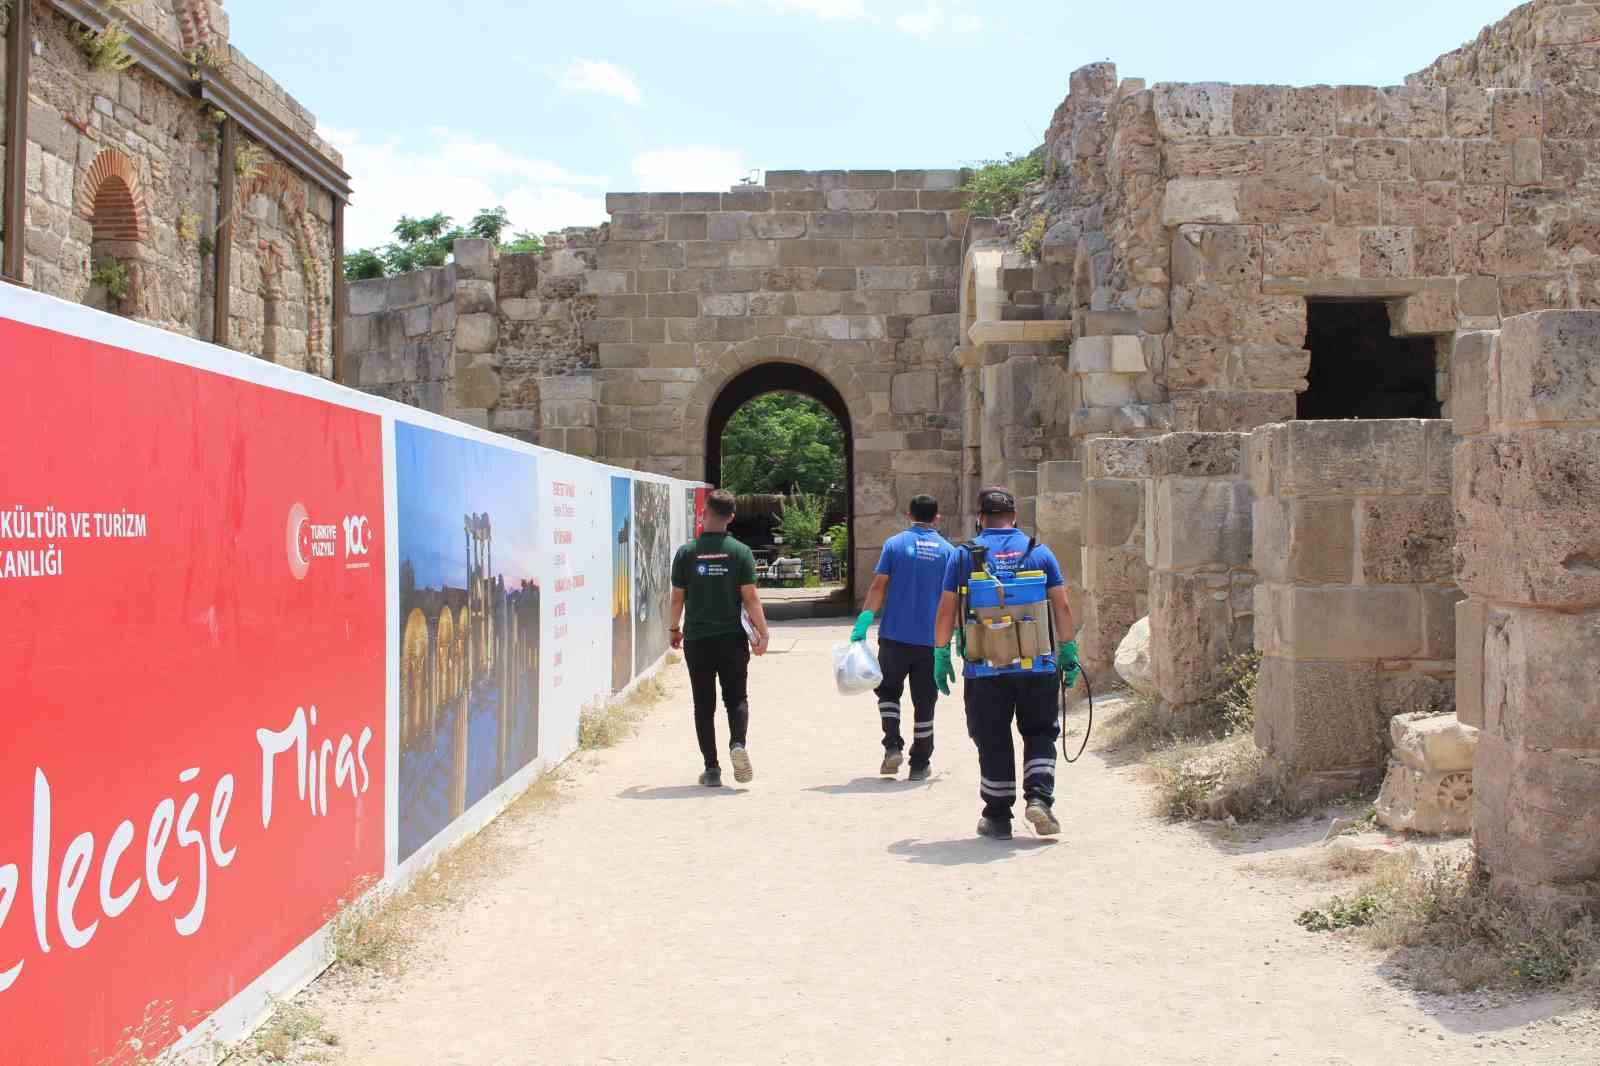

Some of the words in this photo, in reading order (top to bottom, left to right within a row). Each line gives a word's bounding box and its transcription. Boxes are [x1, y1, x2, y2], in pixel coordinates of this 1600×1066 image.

[0, 504, 67, 539] KÜLTÜR
[70, 512, 91, 538] VE
[93, 507, 147, 538] TURİZM
[0, 543, 63, 579] ANLIĞI
[256, 704, 373, 830] Miras
